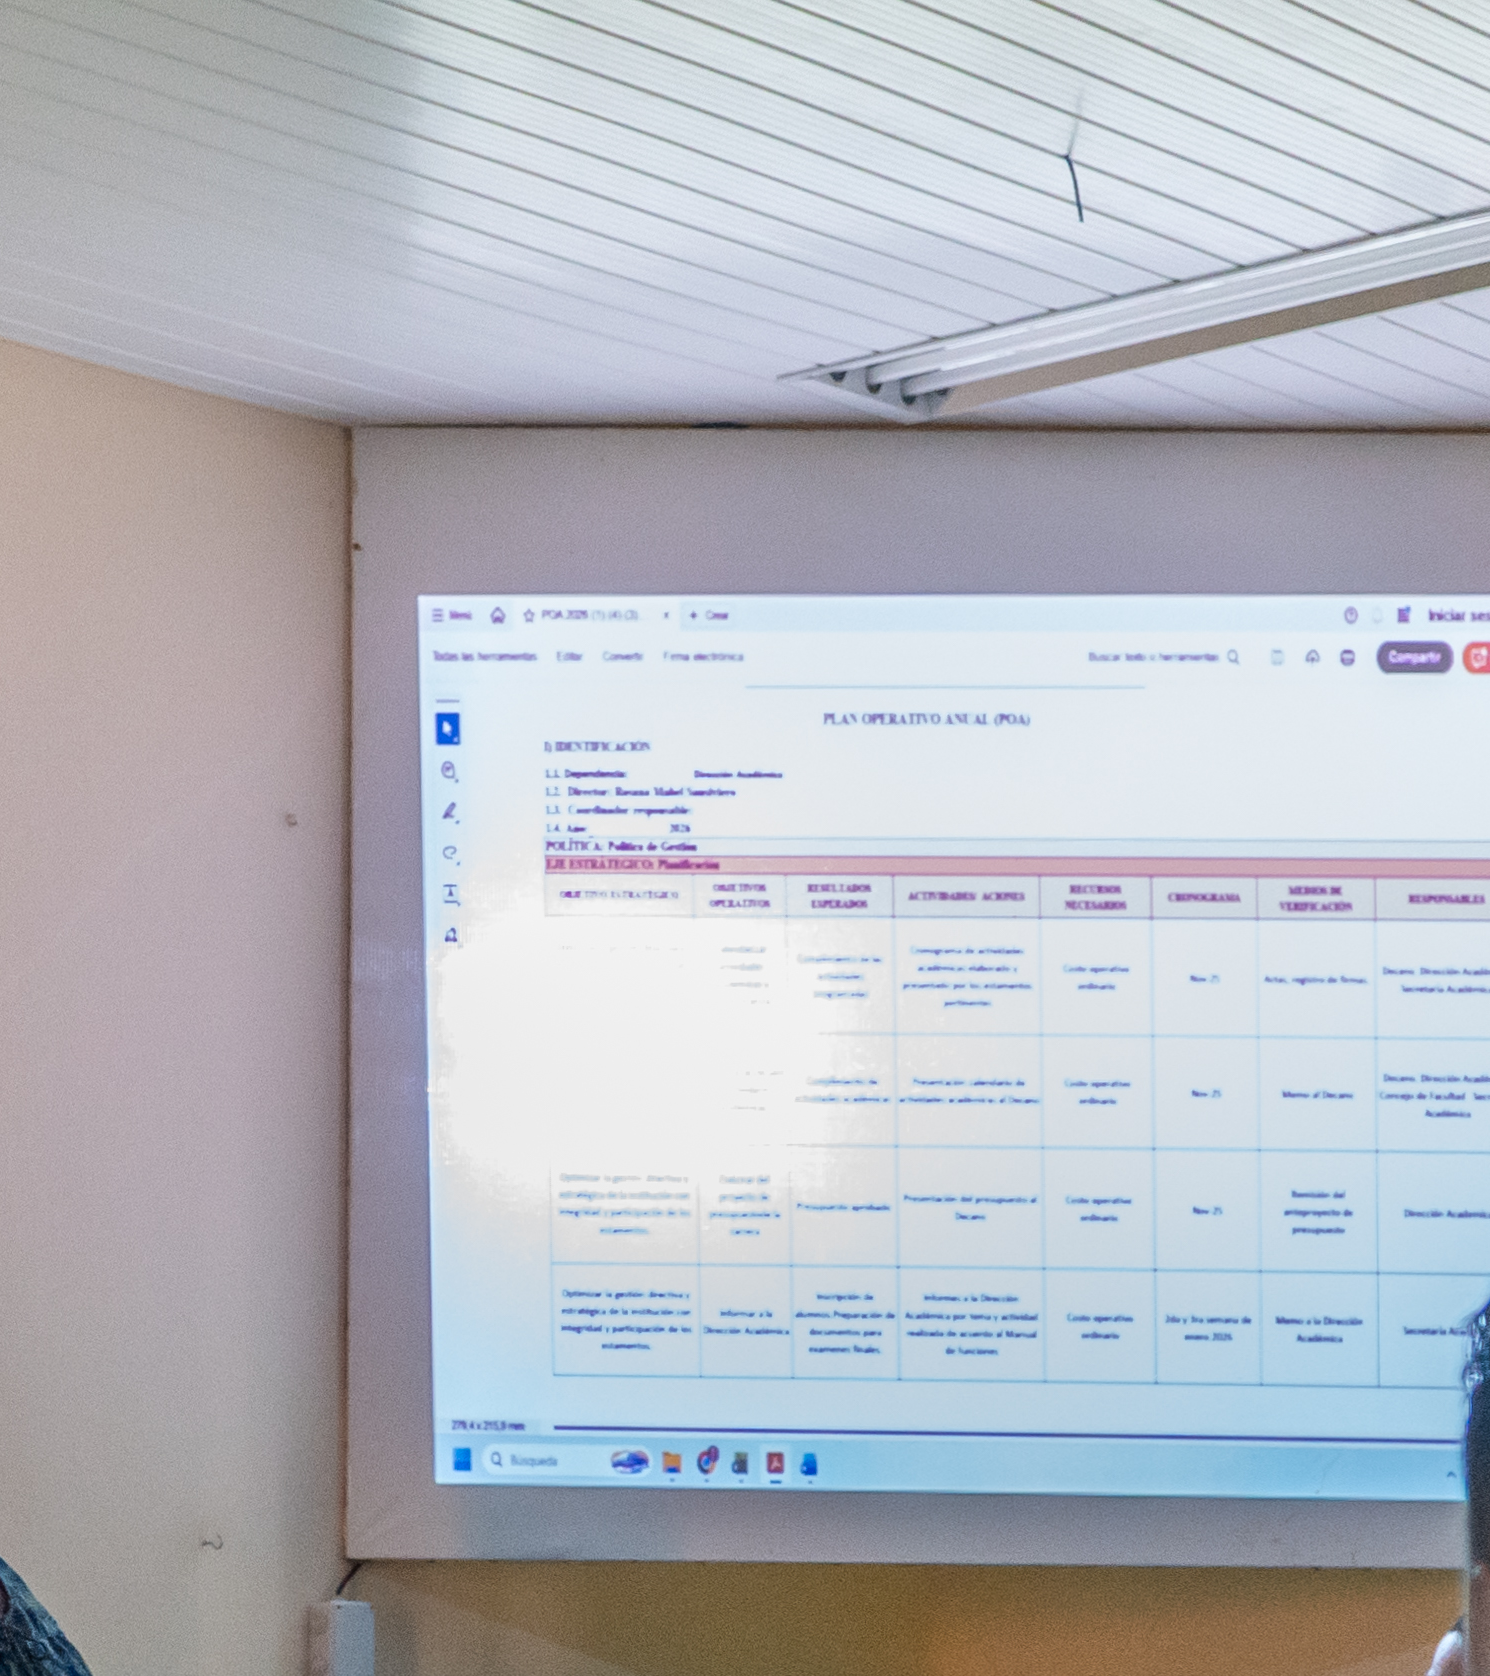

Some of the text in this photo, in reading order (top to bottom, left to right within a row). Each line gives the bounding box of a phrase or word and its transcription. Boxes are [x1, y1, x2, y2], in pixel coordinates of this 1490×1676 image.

[1429, 608, 1465, 623] Iniciar
[1389, 650, 1441, 666] Compartir
[511, 1454, 558, 1468] Búsqueda
